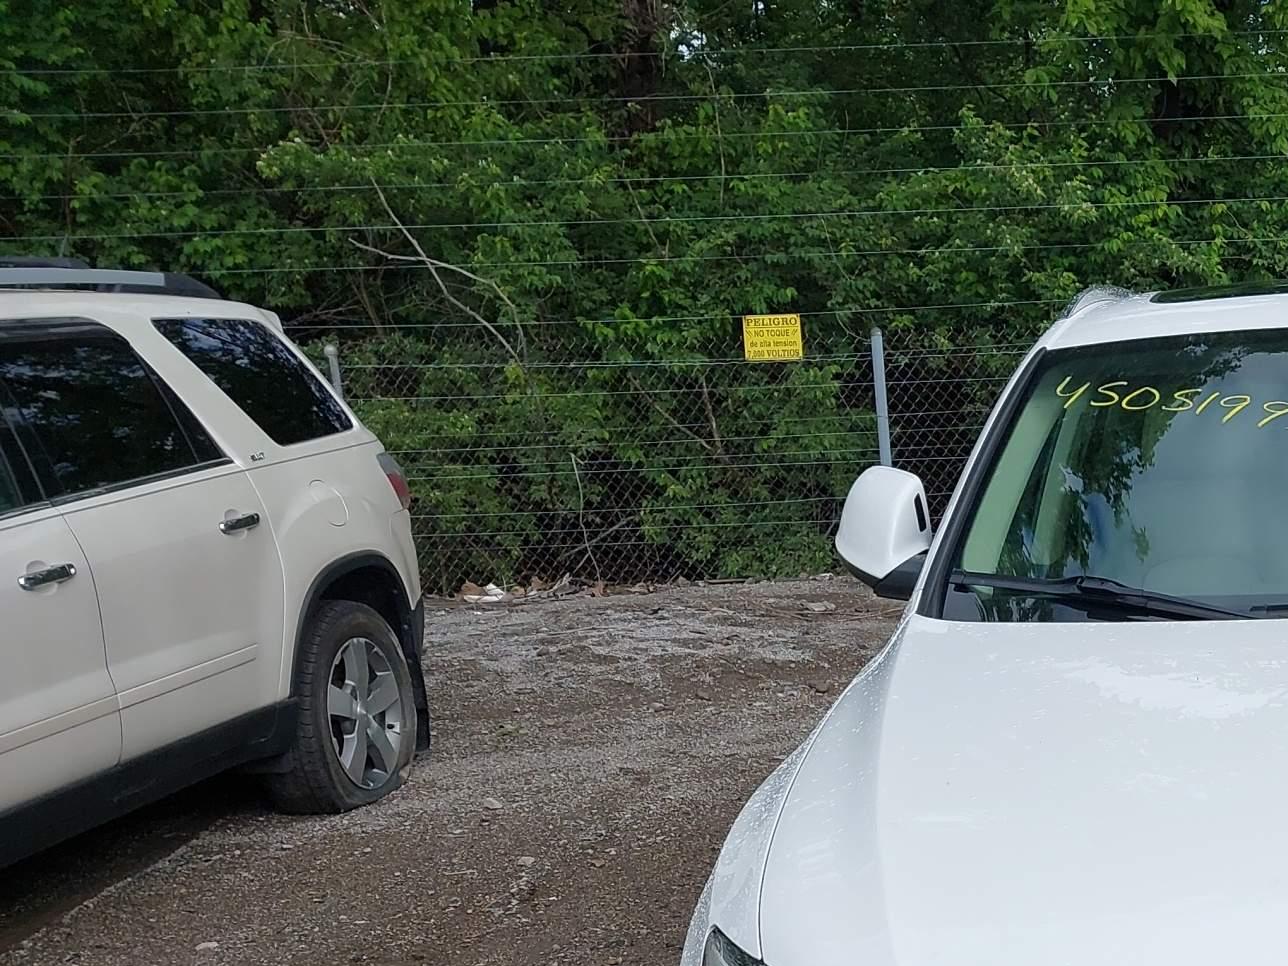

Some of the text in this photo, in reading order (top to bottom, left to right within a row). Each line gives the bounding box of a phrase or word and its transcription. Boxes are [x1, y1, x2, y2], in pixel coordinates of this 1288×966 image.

[746, 317, 797, 326] PELIGRO
[766, 329, 789, 337] TOQUE
[767, 349, 799, 357] VOLTIOS
